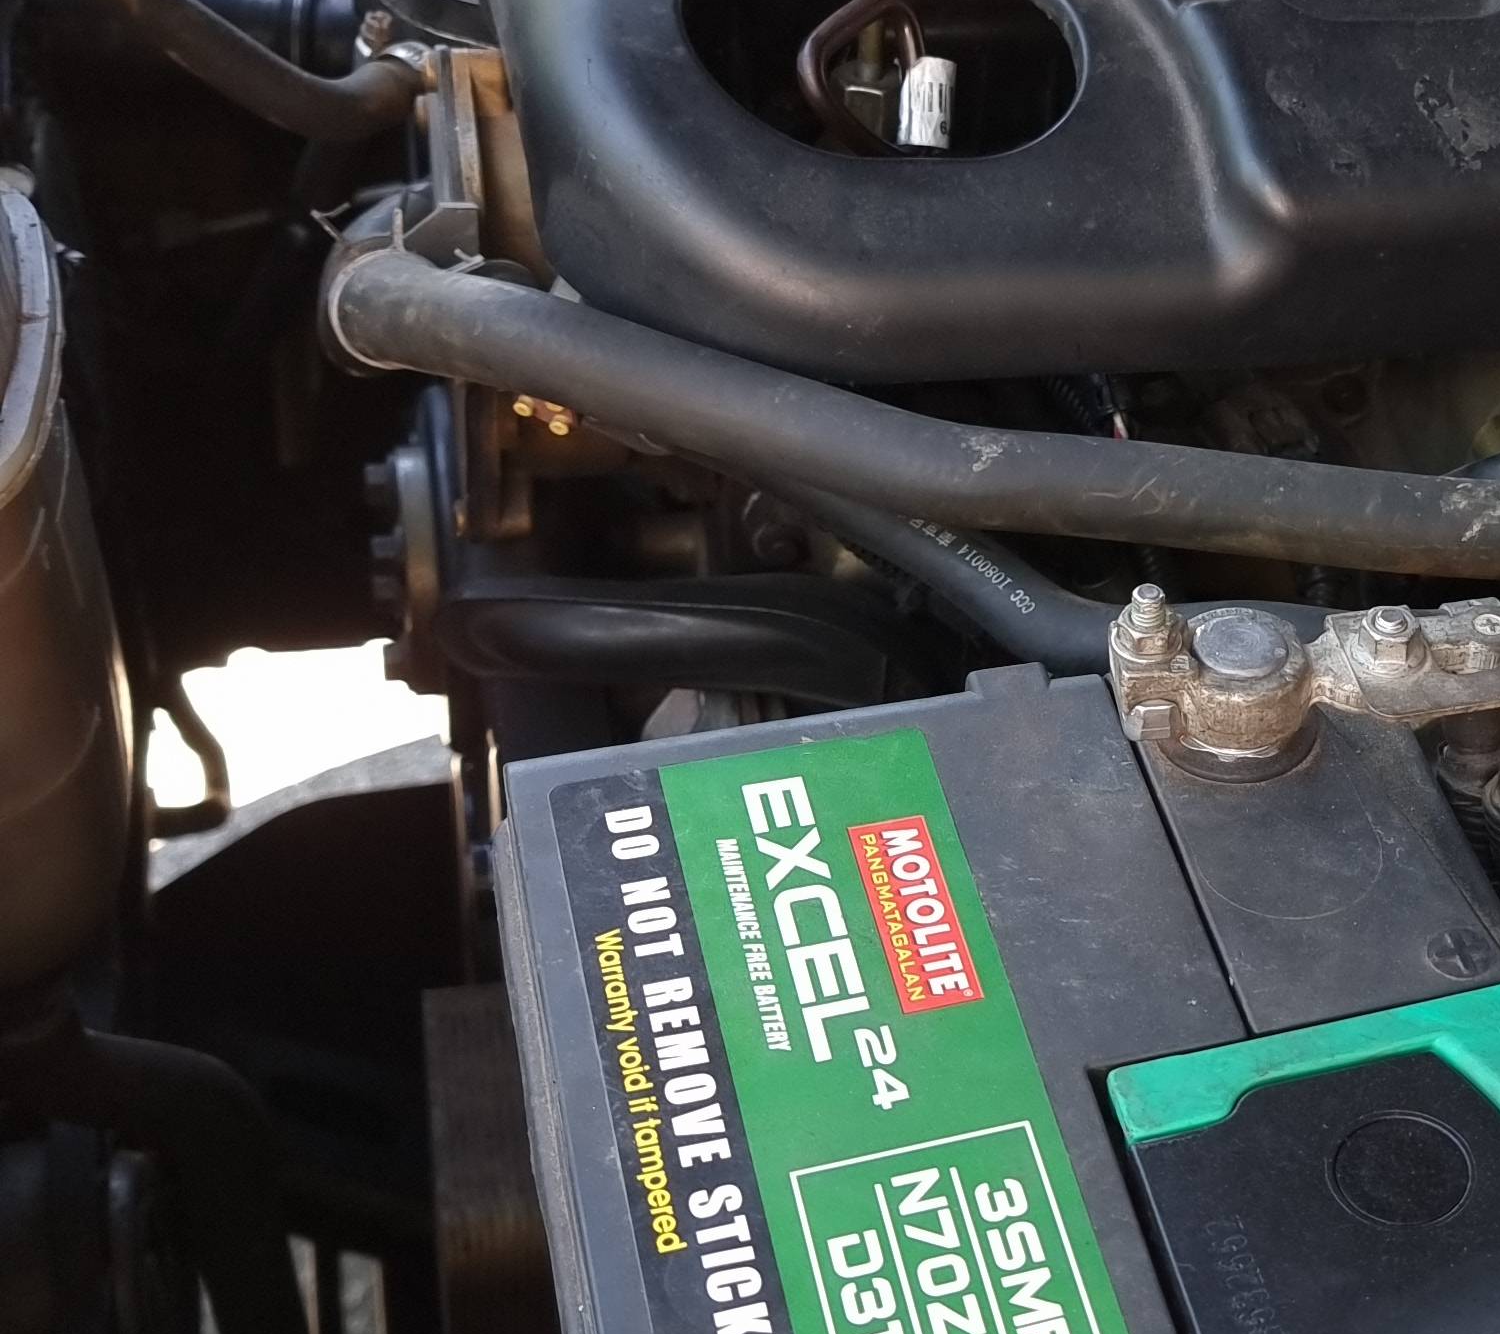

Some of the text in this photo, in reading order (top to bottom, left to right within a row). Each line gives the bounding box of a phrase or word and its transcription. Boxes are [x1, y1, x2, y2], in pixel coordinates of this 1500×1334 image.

[1010, 589, 1036, 614] CCC
[604, 805, 660, 861] DO
[620, 877, 684, 960] NOT
[859, 833, 926, 1002] PANGMATAGALAN
[881, 827, 966, 998] MOTOLITE
[715, 838, 792, 1052] MAINTENANCE FREE BATTERY
[741, 776, 911, 1111] EXCEL 24
[594, 928, 688, 1255] Warranty void if tampered
[642, 975, 732, 1169] REMOVE
